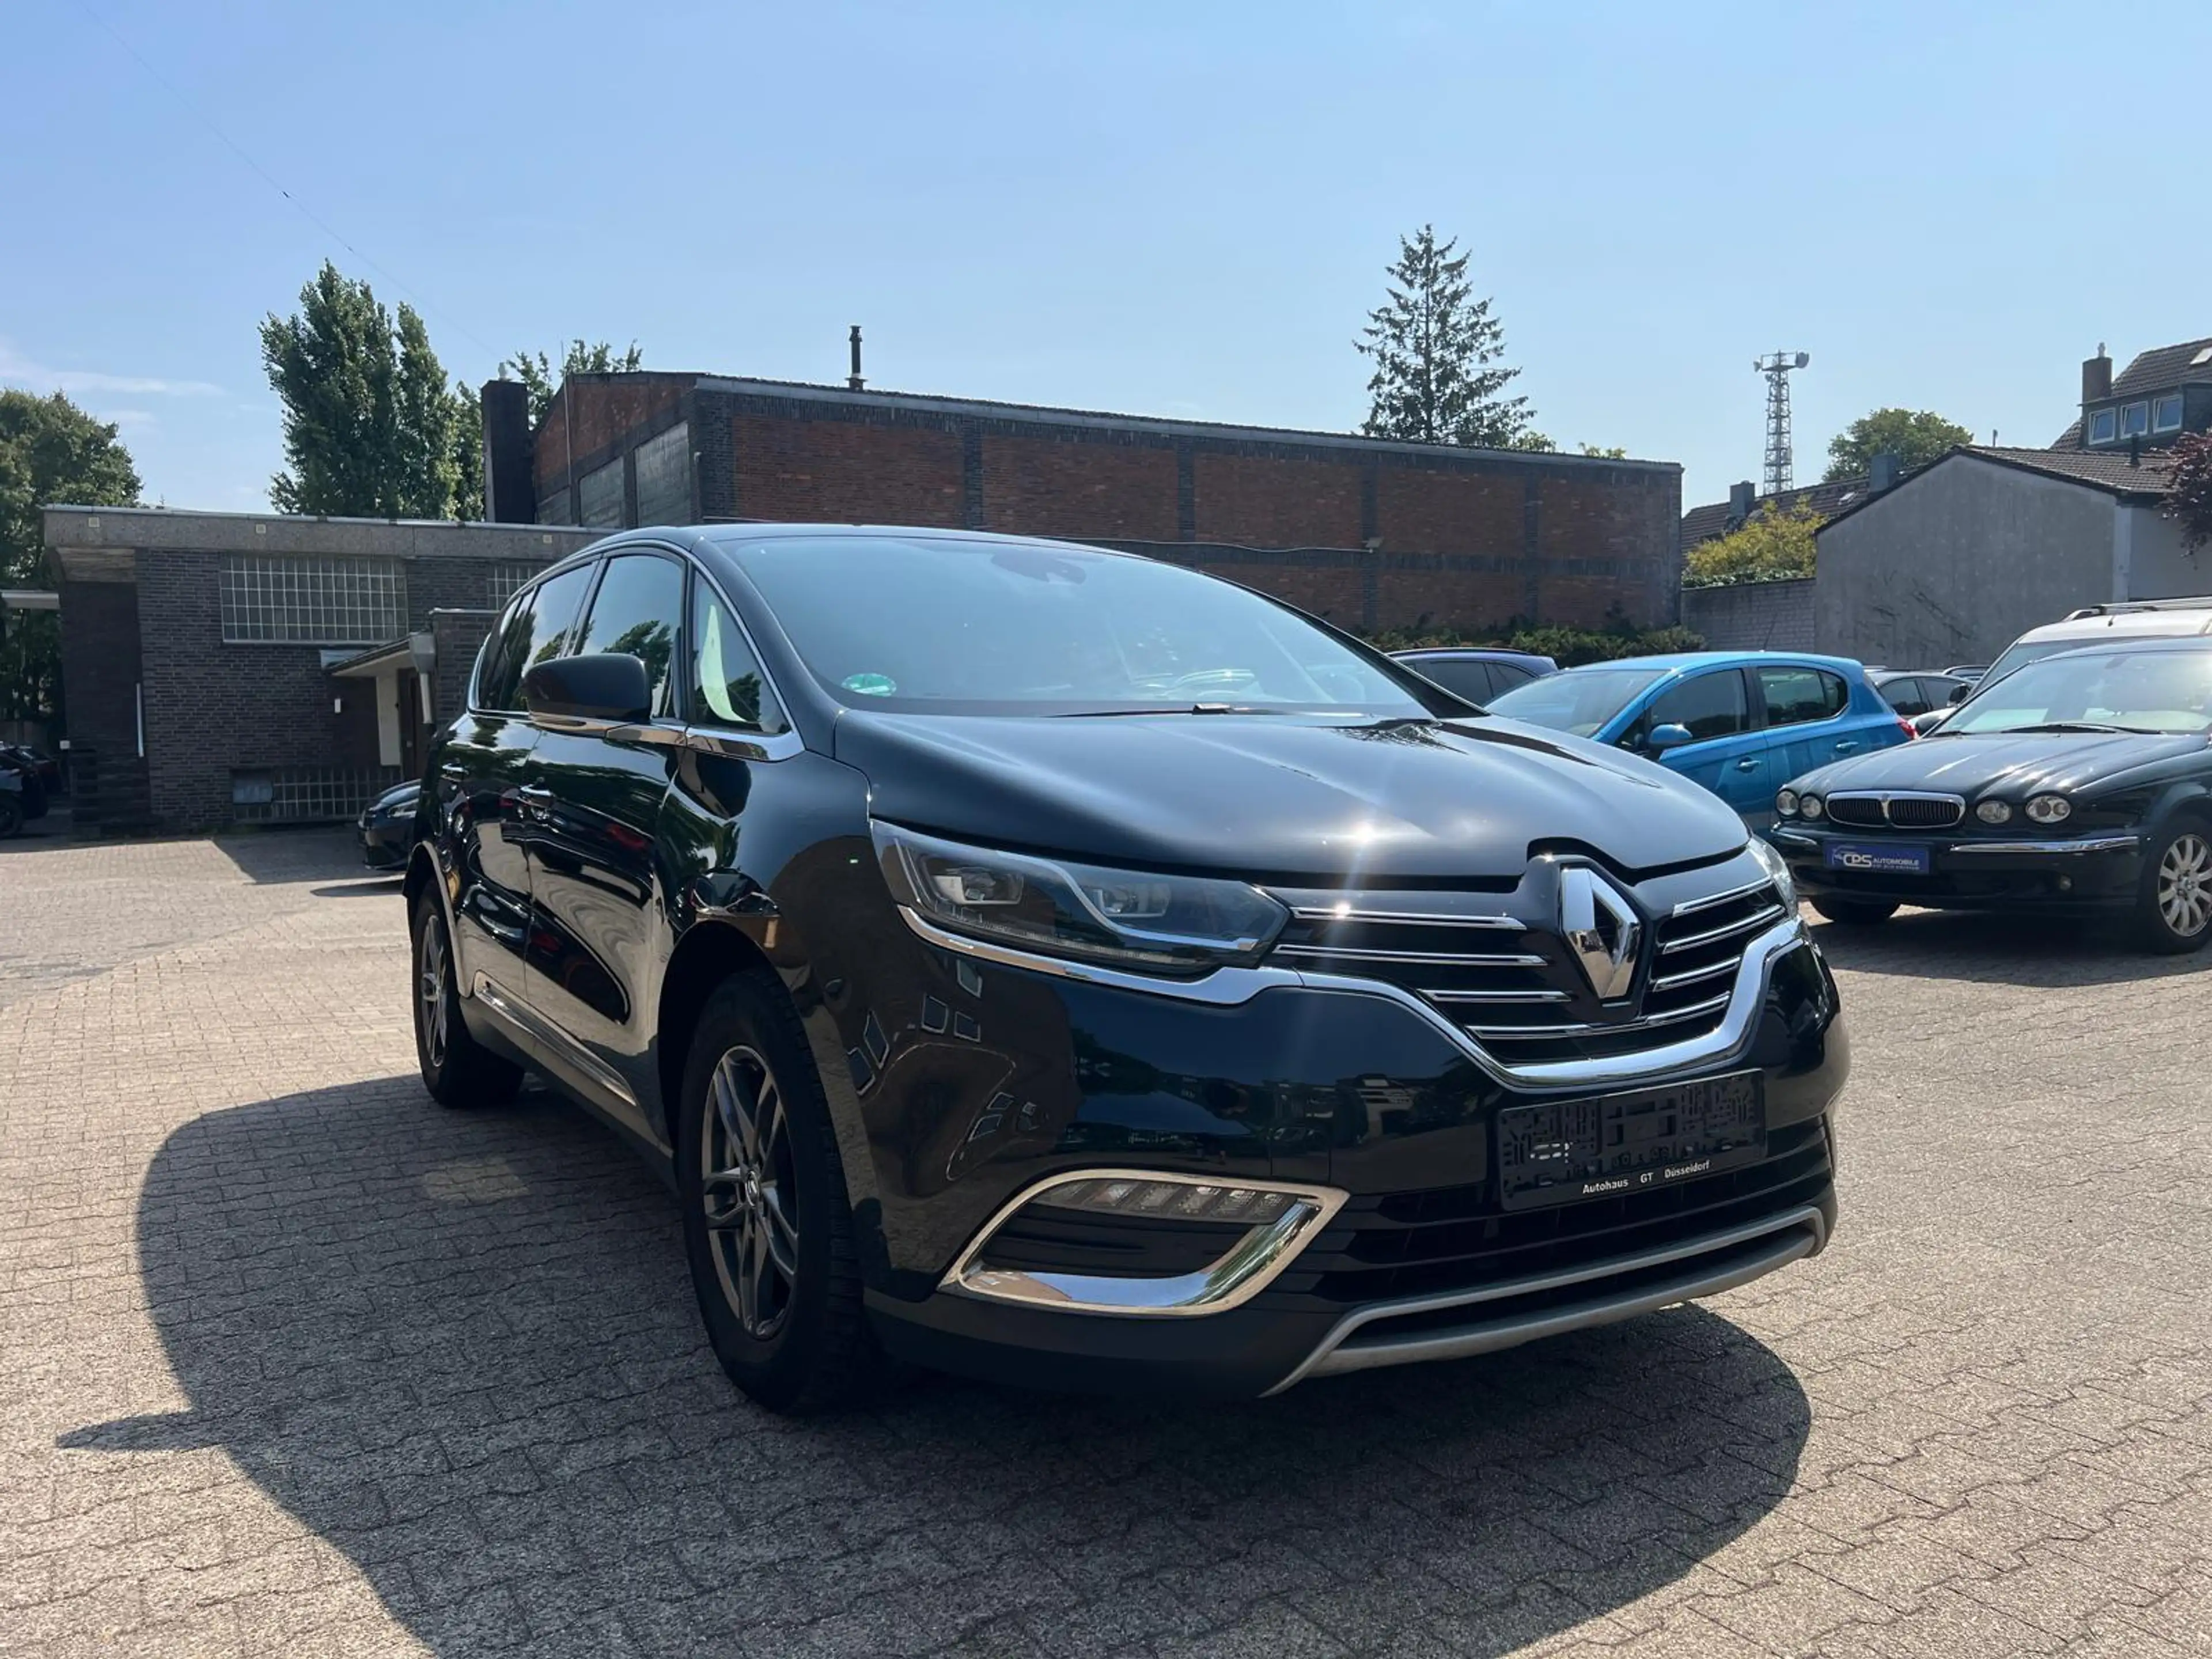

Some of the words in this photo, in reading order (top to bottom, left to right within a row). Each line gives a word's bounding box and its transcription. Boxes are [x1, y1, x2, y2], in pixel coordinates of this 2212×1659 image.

[1843, 854, 1872, 868] CPS
[1873, 858, 1920, 866] AUTOMOBILE
[1582, 1179, 1628, 1194] Autohaus
[1640, 1172, 1654, 1183] GT
[1664, 1159, 1710, 1179] Düsseldorf
